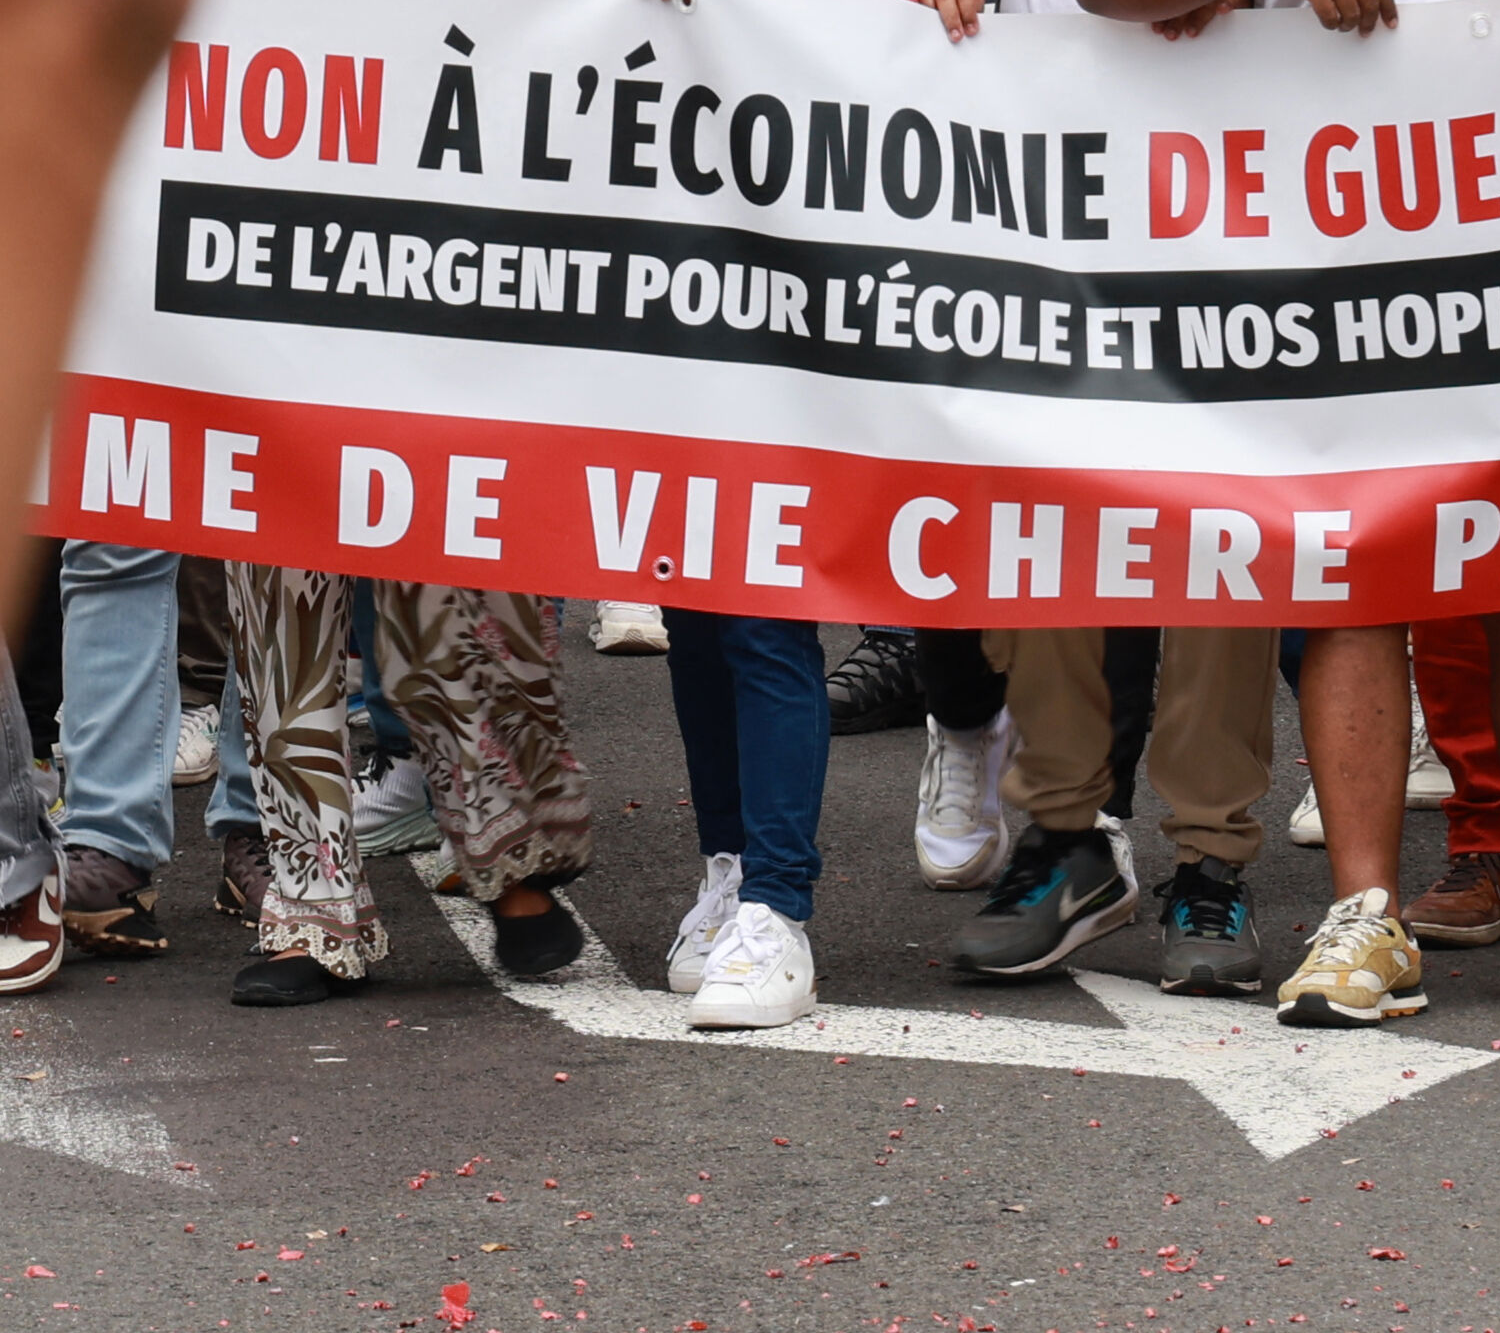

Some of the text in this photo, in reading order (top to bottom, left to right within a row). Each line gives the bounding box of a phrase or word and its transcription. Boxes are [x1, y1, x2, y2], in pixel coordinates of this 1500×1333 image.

[162, 40, 385, 166] NON
[418, 23, 484, 175] À
[1148, 128, 1270, 240] DE
[185, 217, 276, 287] DE
[625, 253, 811, 338] POUR
[1086, 303, 1161, 371] ET
[1177, 300, 1323, 370] NOS
[28, 412, 260, 534] ME
[338, 445, 508, 561] DE
[586, 465, 811, 589] VIE
[888, 496, 1352, 603] CHERE
